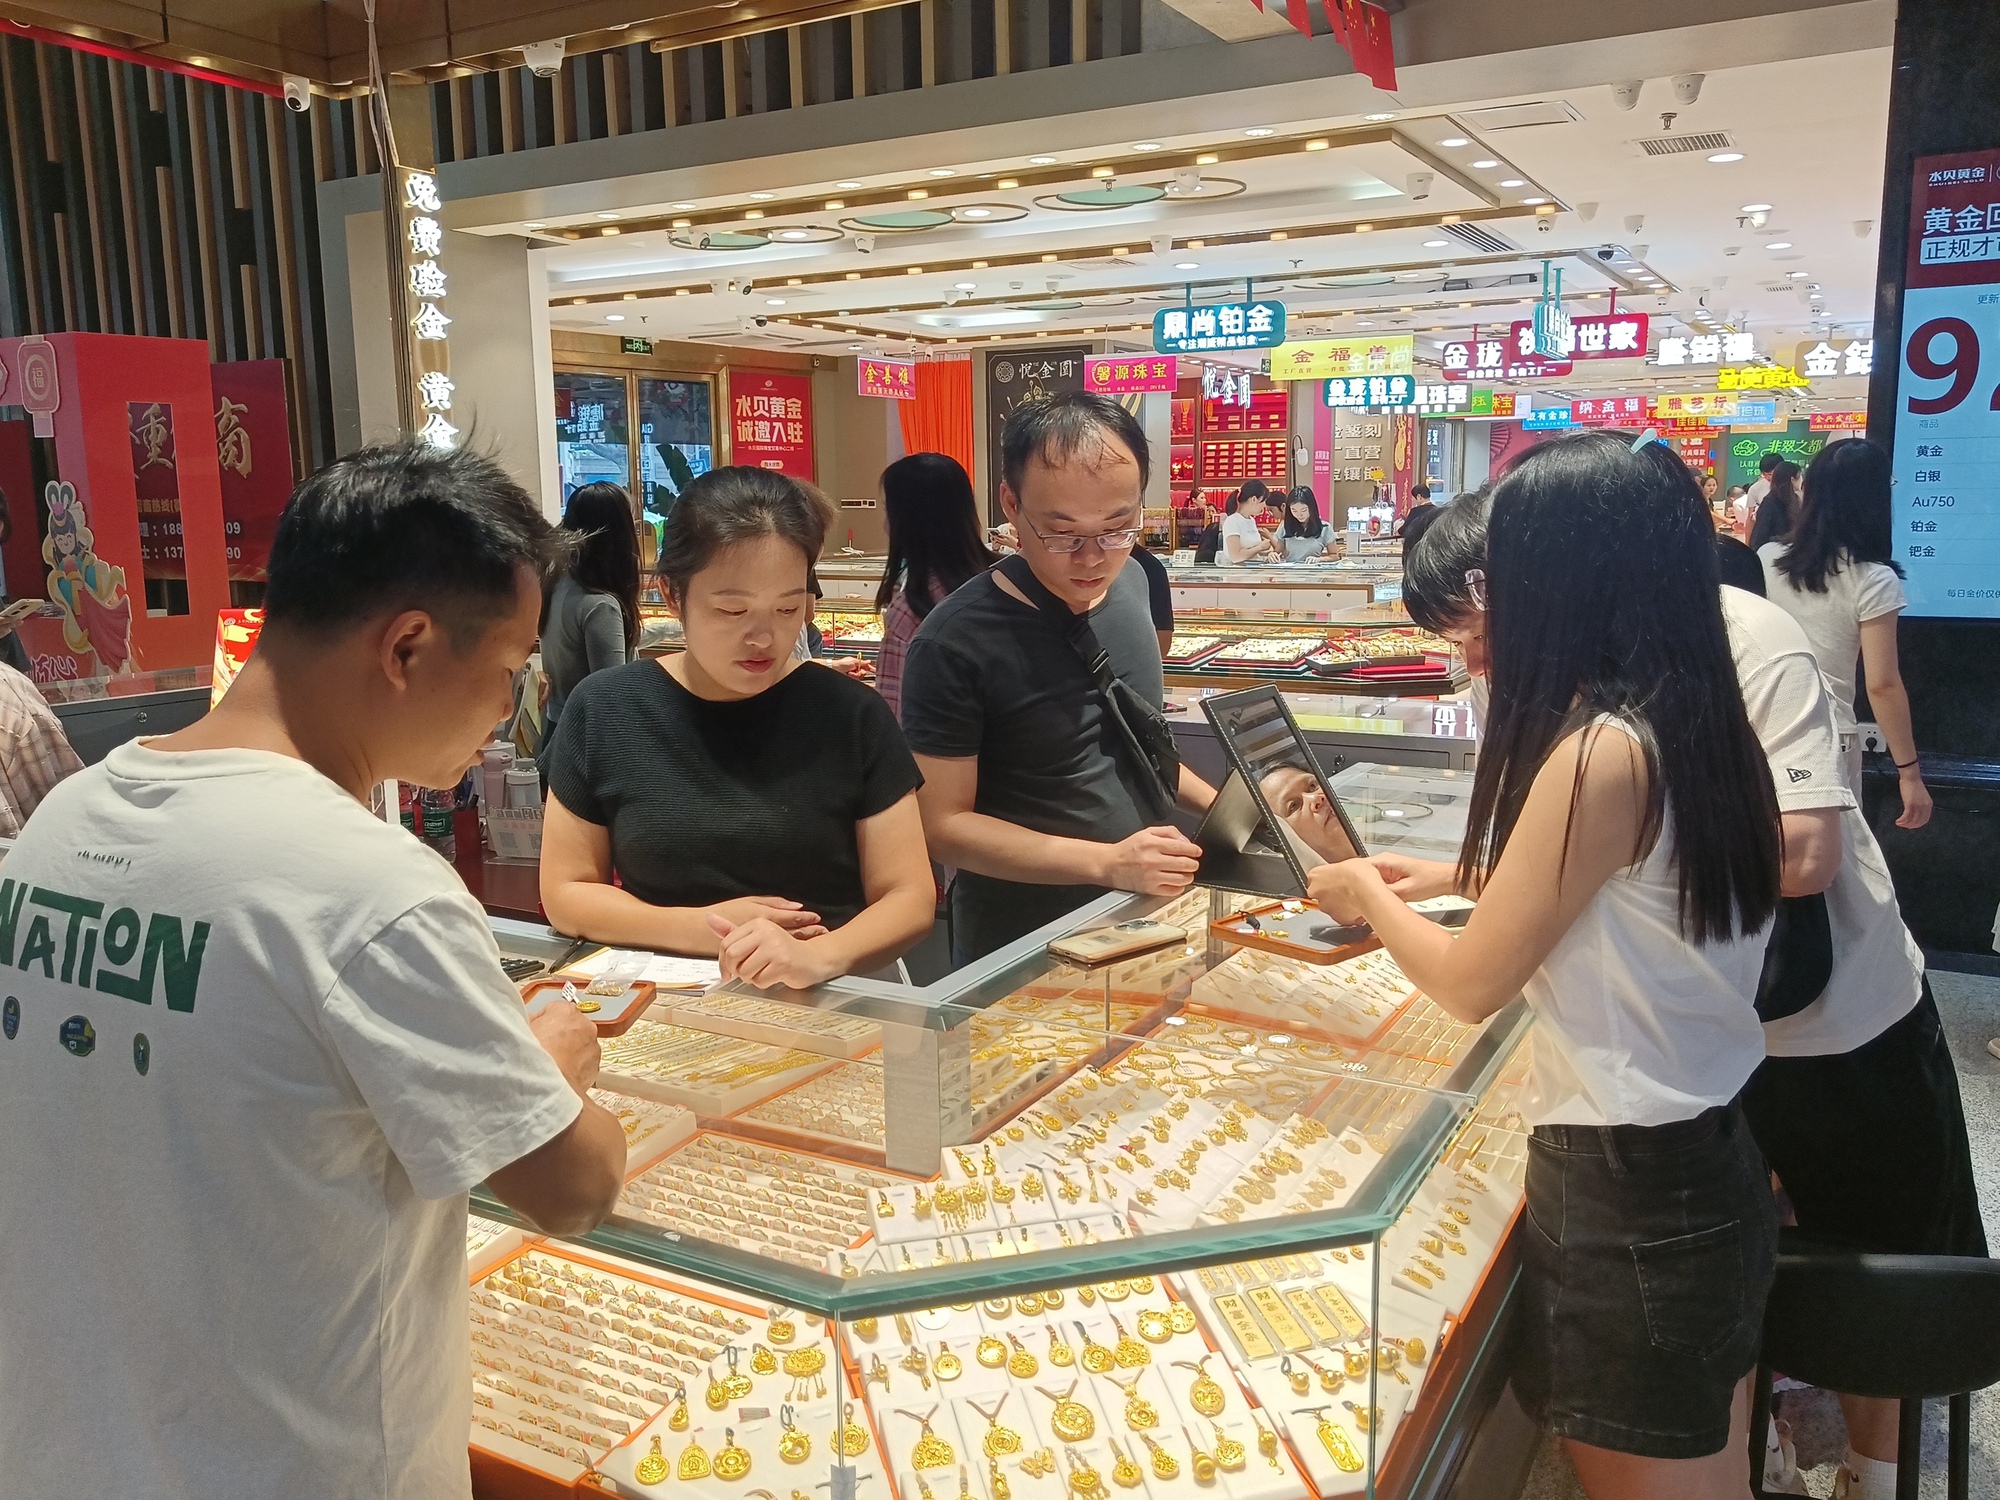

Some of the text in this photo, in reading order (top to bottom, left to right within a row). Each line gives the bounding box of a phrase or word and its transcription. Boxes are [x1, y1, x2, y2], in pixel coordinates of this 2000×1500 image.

[1929, 167, 1985, 182] 水贝黄金
[1163, 304, 1274, 339] 鼎尚铂金
[1518, 321, 1638, 356] 世家
[1097, 362, 1168, 381] 馨源珠宝
[1906, 317, 2000, 415] 9
[32, 367, 45, 388] 福
[417, 370, 459, 449] 黄金
[736, 395, 802, 419] 水贝黄金
[737, 420, 803, 443] 诚邀入驻
[1916, 445, 1943, 457] 黄金
[1914, 469, 1941, 483] 白银
[1912, 496, 1955, 507] Au750
[1910, 520, 1938, 533] 铂金
[1909, 545, 1936, 558] 钯金
